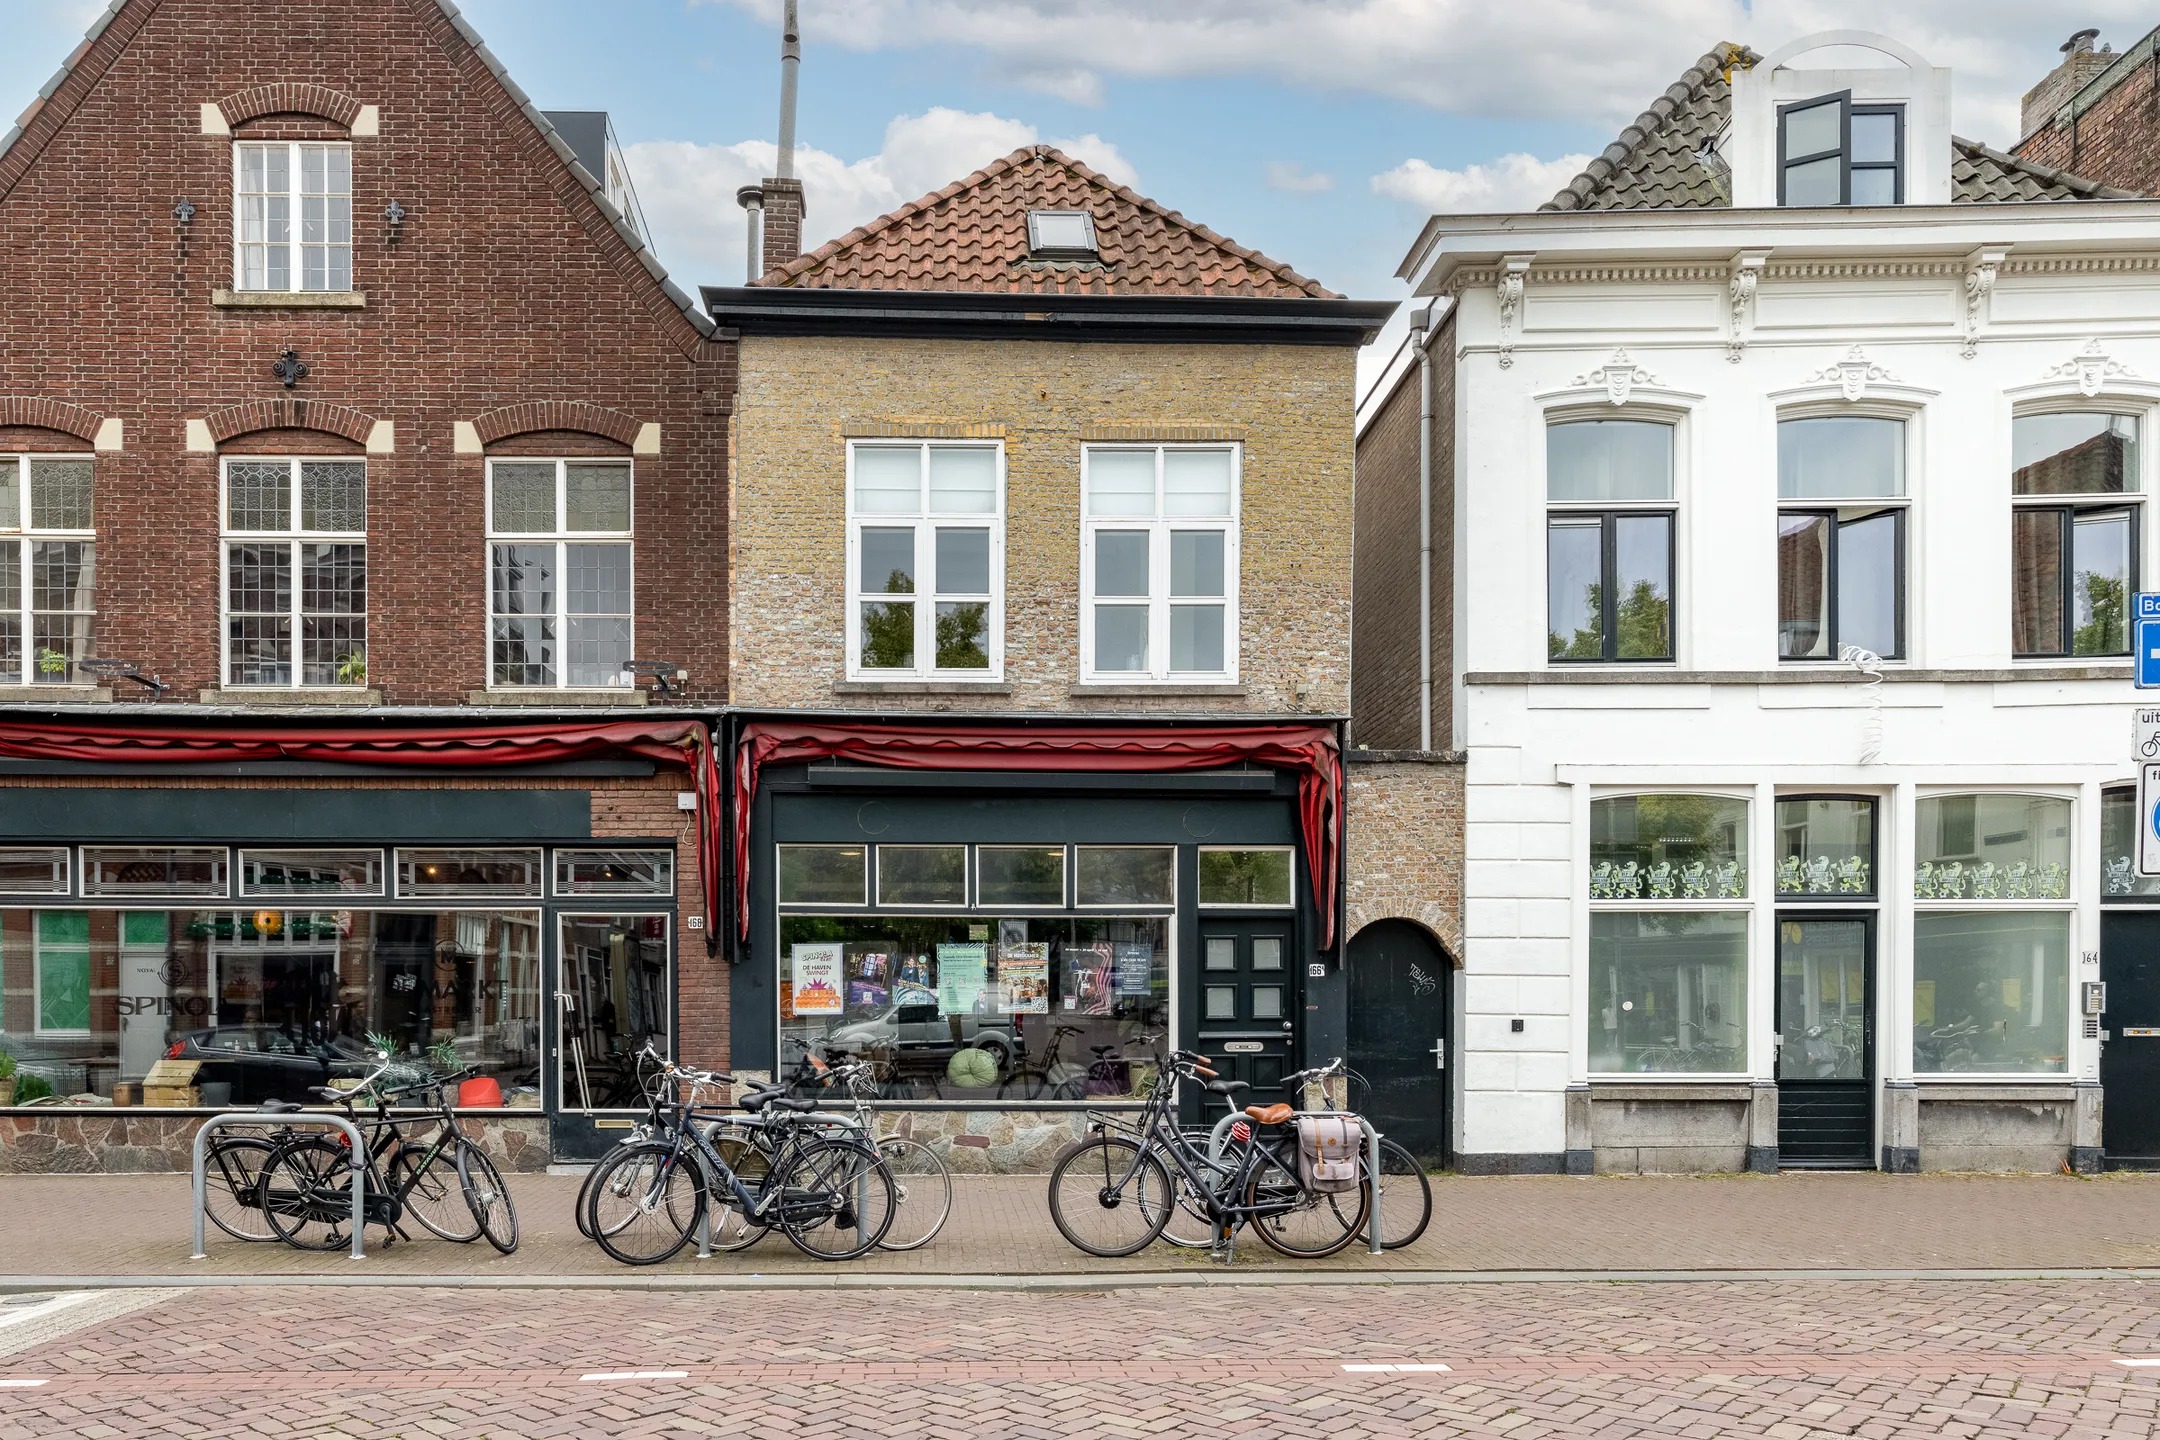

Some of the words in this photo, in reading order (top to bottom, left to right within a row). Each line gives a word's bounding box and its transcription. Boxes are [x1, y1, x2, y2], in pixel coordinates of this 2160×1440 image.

[2142, 712, 2160, 723] uit
[690, 917, 702, 928] 168
[2082, 952, 2098, 964] 164
[417, 979, 508, 1000] MAKT
[115, 996, 230, 1016] SPINOL
[416, 1144, 440, 1175] BATAVUS
[698, 1139, 726, 1170] GAZELLE
